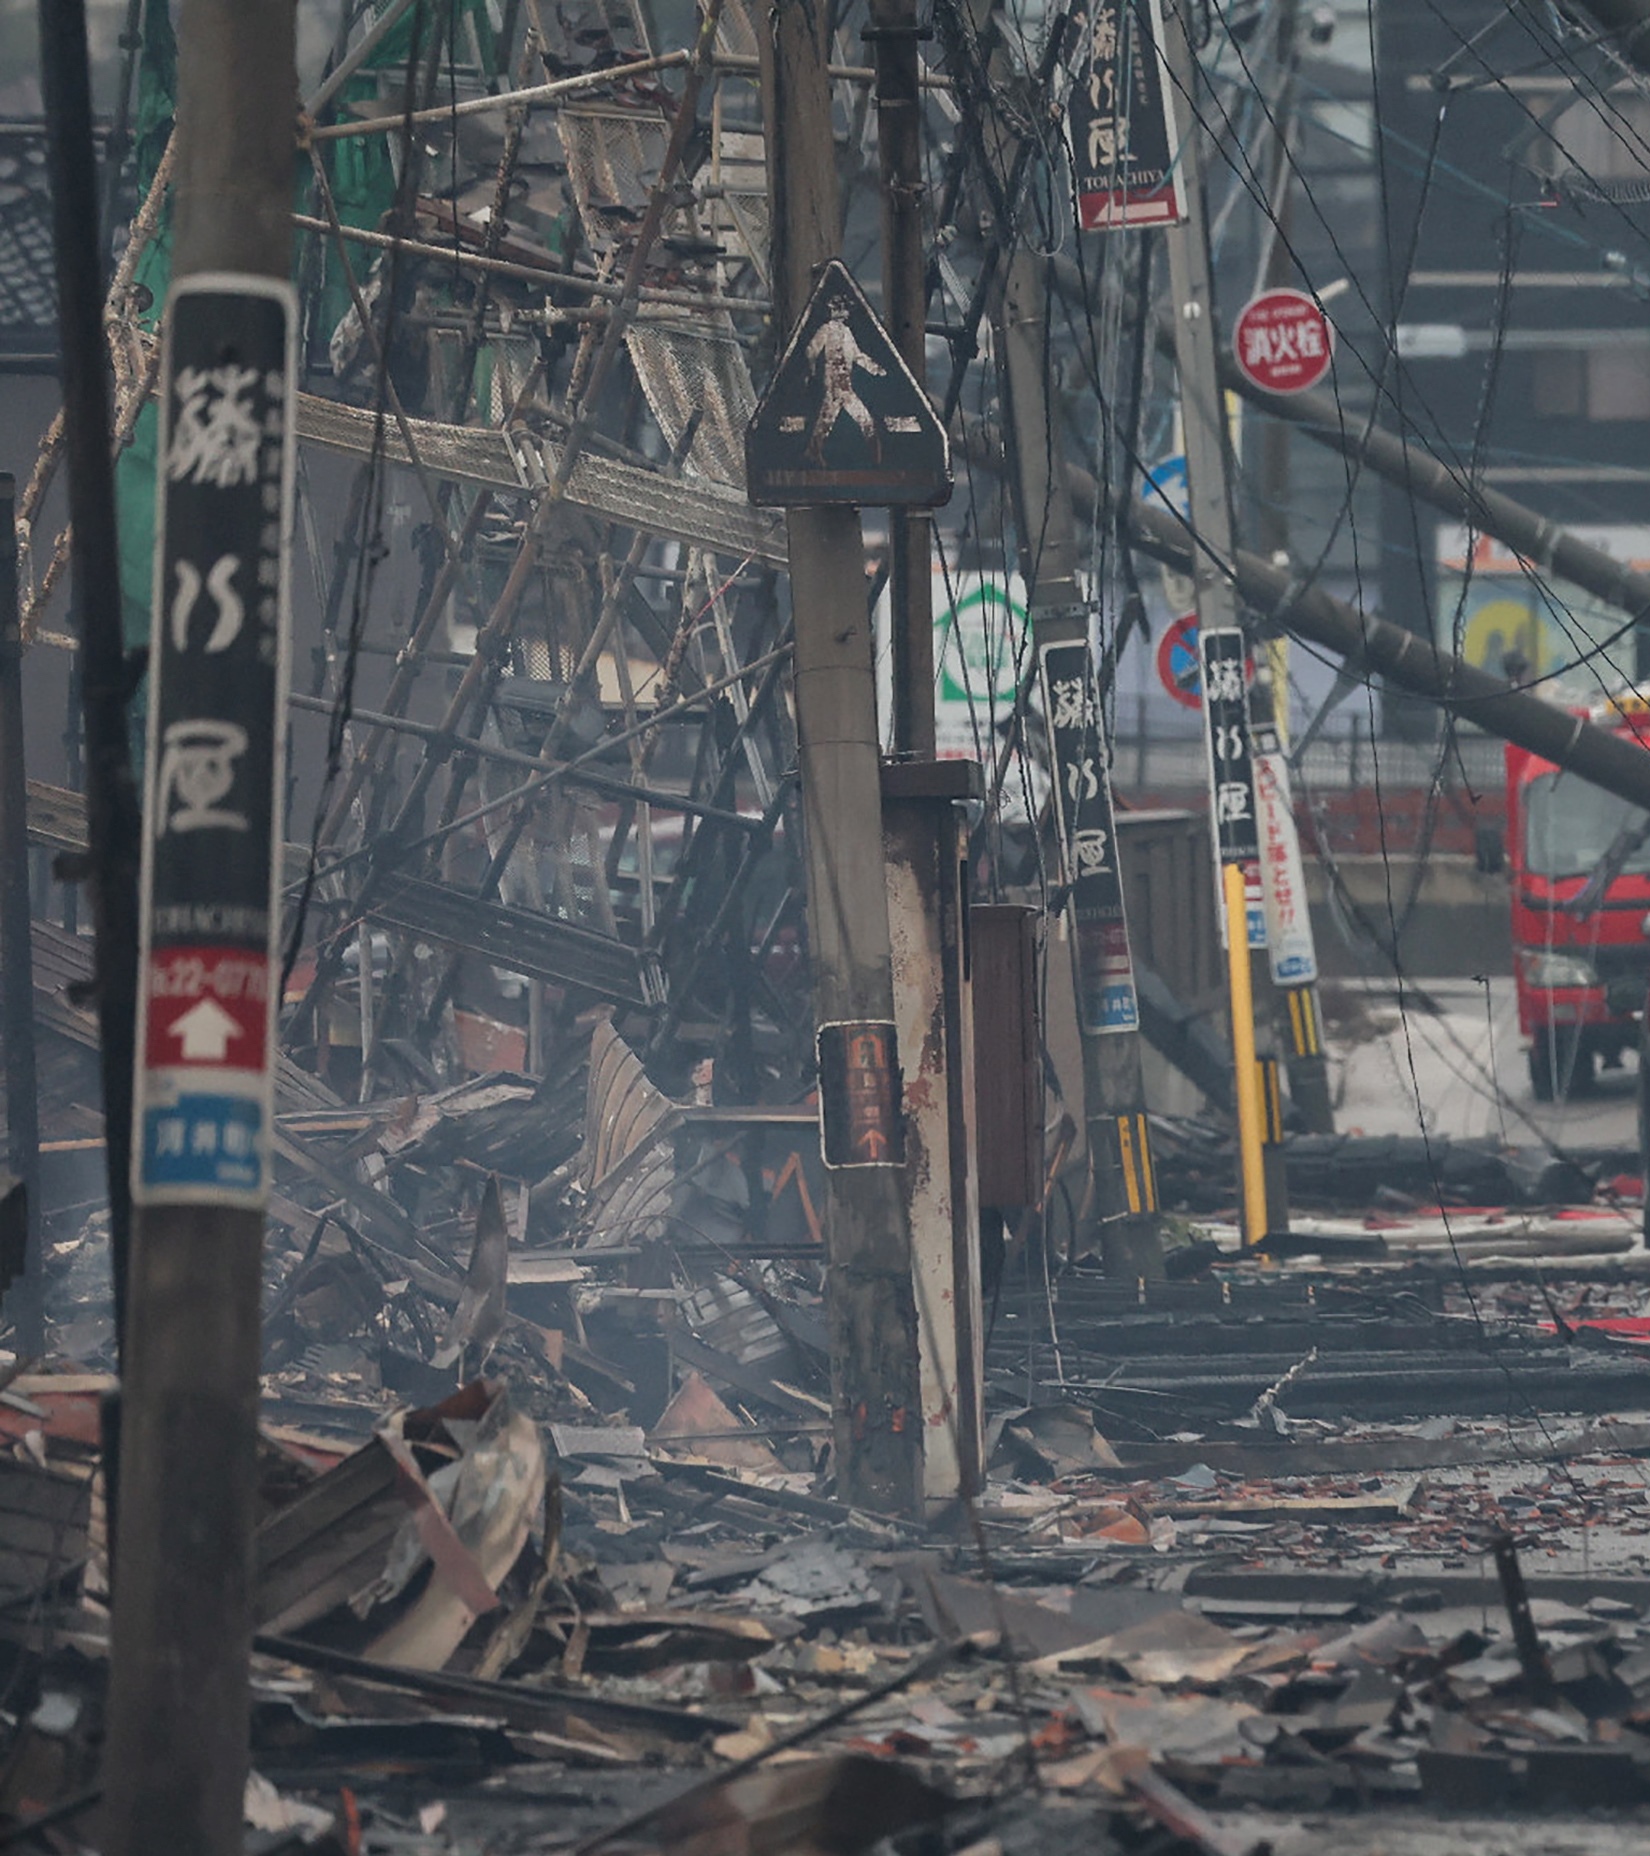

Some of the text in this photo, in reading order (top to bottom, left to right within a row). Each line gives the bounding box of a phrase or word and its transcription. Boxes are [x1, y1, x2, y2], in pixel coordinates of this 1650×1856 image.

[1084, 169, 1165, 190] TOUACHIYA
[1244, 319, 1324, 367] 消火栓
